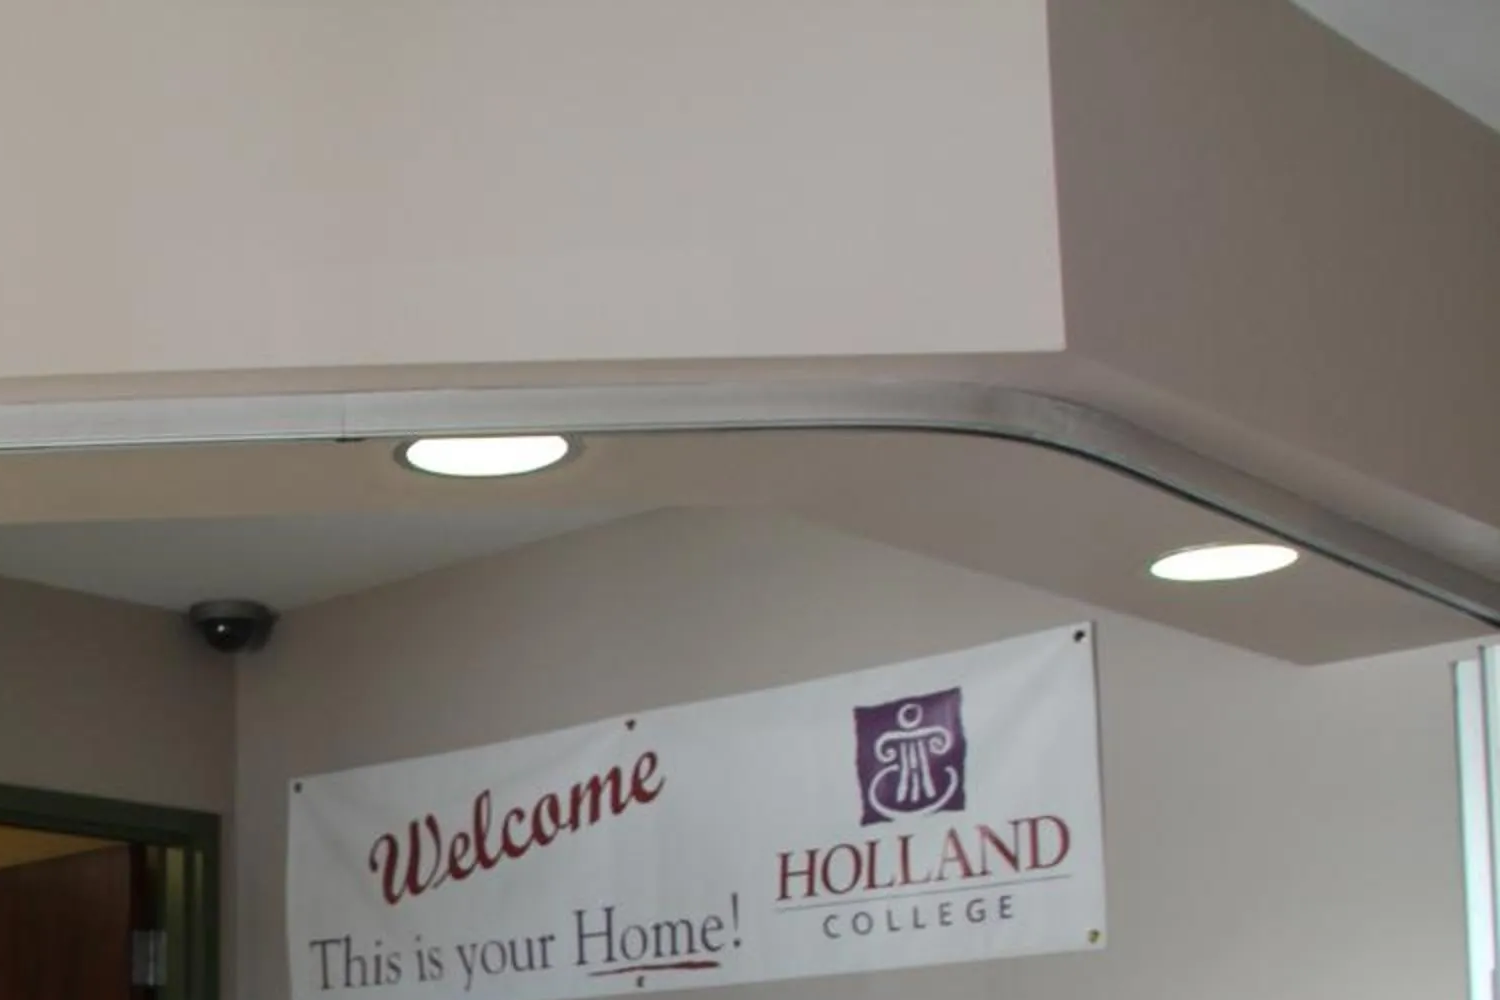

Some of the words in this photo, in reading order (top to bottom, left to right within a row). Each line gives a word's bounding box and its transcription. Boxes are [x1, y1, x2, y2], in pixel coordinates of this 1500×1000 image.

[369, 751, 667, 906] Welcome
[775, 814, 1071, 902] HOLLAND
[309, 934, 403, 991] This
[416, 934, 445, 982] is
[455, 932, 557, 993] your
[572, 892, 743, 967] Home!
[821, 895, 1015, 940] COLLEGE
